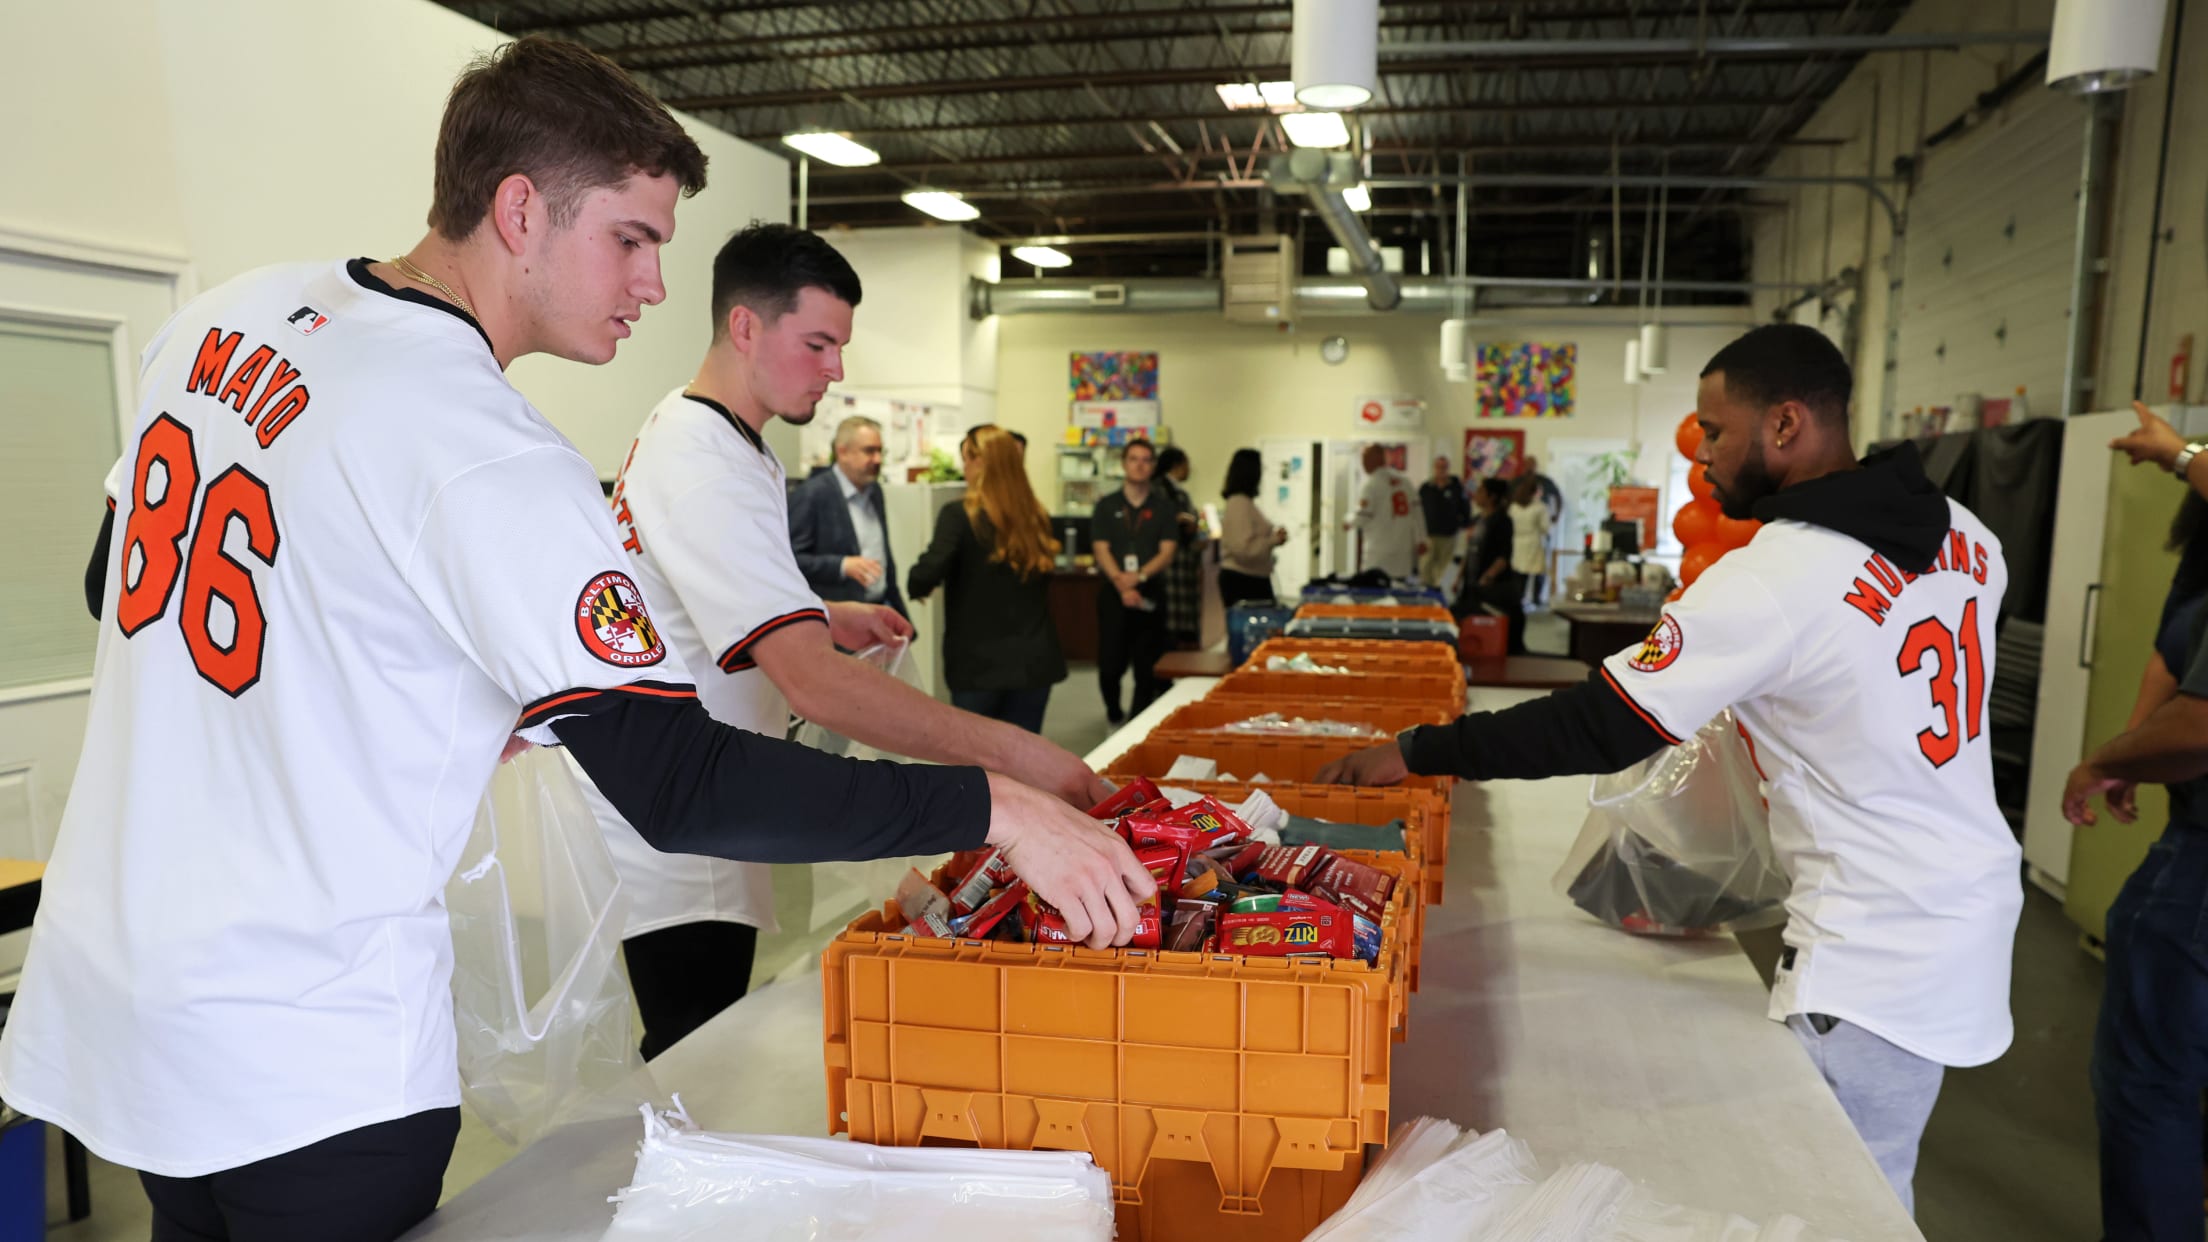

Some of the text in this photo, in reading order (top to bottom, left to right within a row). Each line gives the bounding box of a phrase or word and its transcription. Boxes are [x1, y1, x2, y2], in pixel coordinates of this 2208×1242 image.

[185, 327, 311, 450] MAYO
[117, 410, 281, 699] 86
[1843, 528, 1988, 627] MUINS
[580, 576, 643, 617] BALTIMO
[610, 641, 663, 663] ORIOLE
[1896, 596, 1985, 769] 31
[1190, 813, 1222, 833] RITZ
[1284, 926, 1318, 943] RITZ
